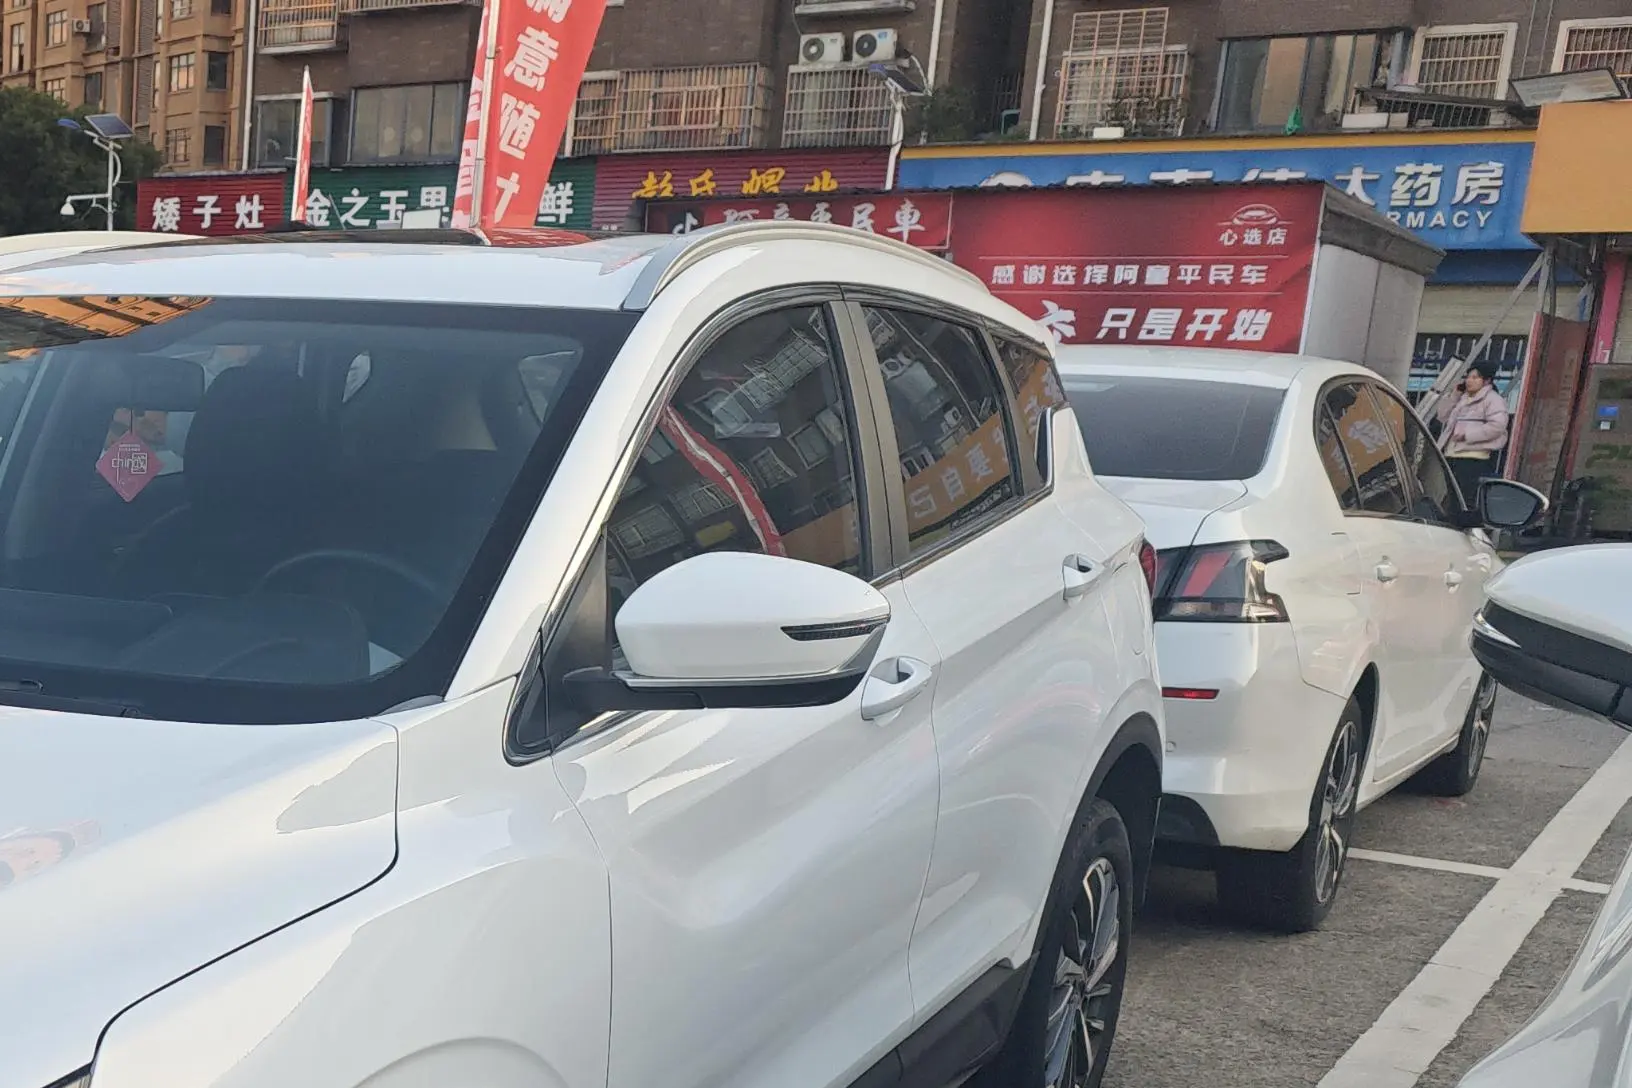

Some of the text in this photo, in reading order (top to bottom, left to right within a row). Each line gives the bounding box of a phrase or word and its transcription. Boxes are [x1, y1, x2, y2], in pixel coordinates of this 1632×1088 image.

[152, 194, 264, 231] 矮子灶
[1219, 228, 1287, 246] 心选店
[992, 264, 1269, 285] 感谢选择阿童平民车
[1096, 307, 1272, 342] 只是开始
